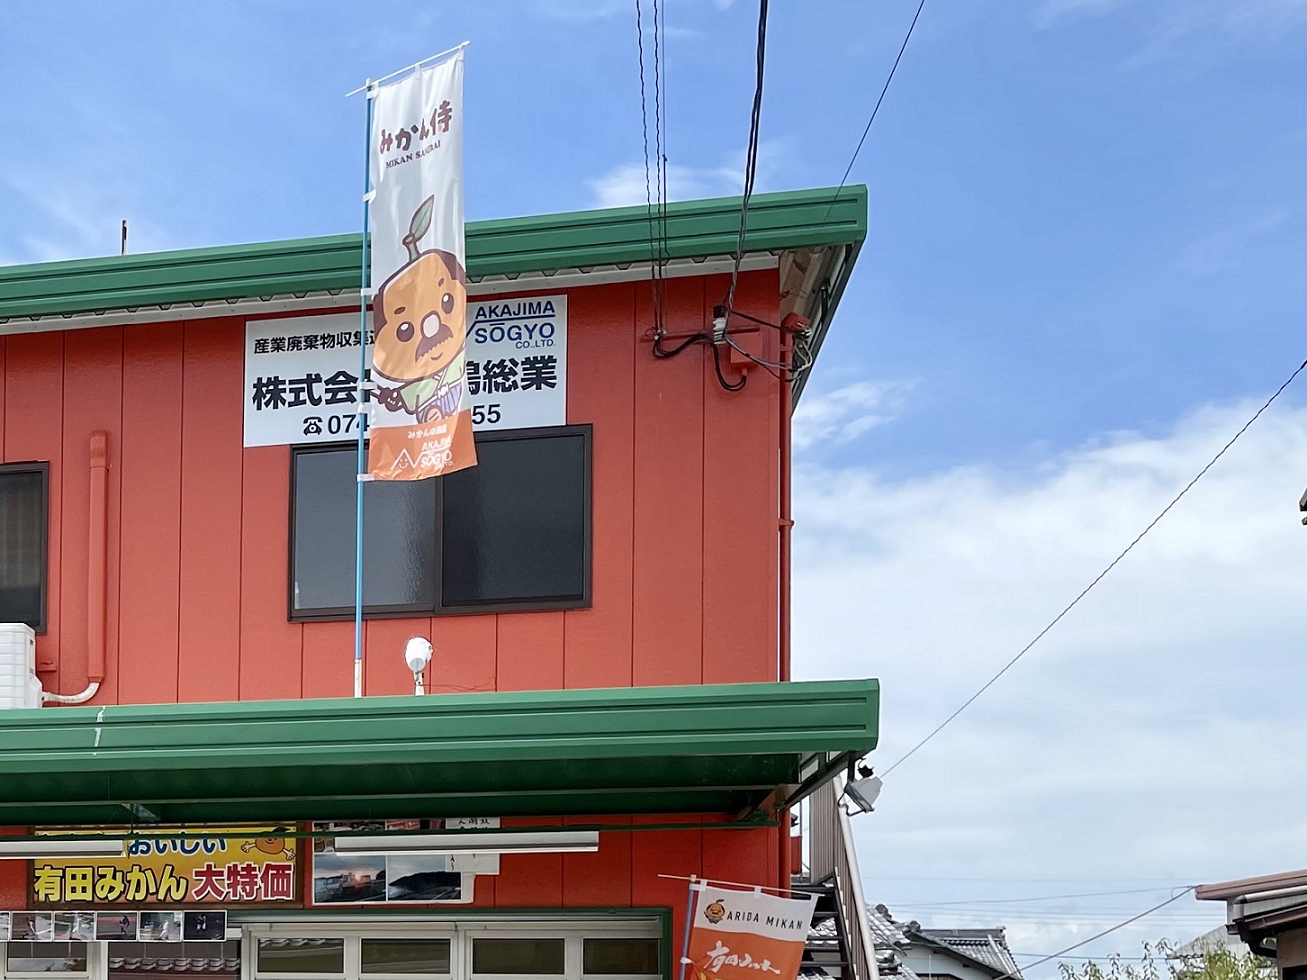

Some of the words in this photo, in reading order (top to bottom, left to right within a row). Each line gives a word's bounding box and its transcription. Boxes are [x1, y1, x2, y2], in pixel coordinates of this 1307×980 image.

[380, 100, 453, 154] みかん侍
[386, 153, 413, 169] MIKAN
[475, 301, 555, 319] AKAJIMA
[130, 831, 227, 855] おいしい
[727, 910, 759, 923] ARIDA
[766, 915, 803, 930] MIKAN
